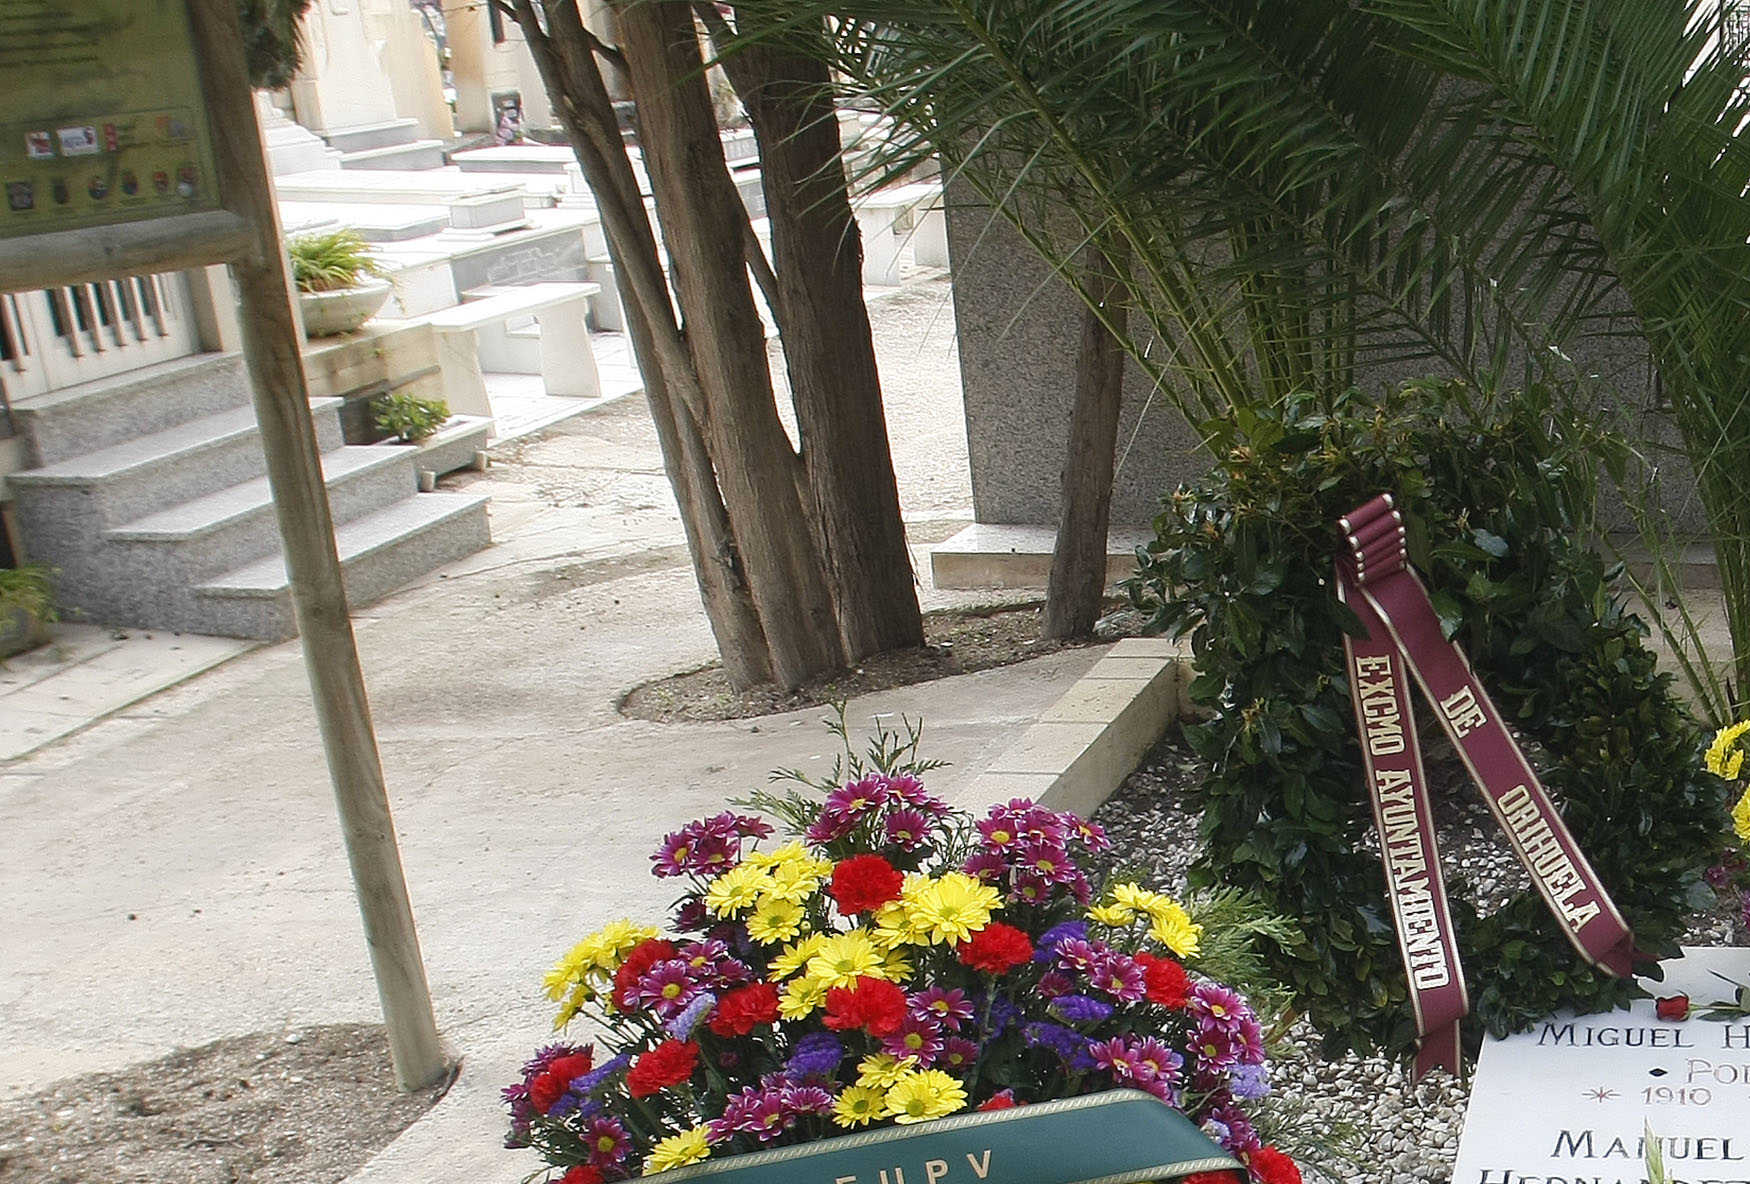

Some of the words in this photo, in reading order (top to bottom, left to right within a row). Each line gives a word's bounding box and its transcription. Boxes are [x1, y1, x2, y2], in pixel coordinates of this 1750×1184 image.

[1354, 654, 1405, 757] EXCMO
[1440, 686, 1487, 738] DE
[1498, 784, 1601, 933] ORIHUELA
[1376, 769, 1450, 991] AYUNTAMIENTO
[1538, 1022, 1695, 1048] MIGUEL
[1640, 1087, 1712, 1106] 1910
